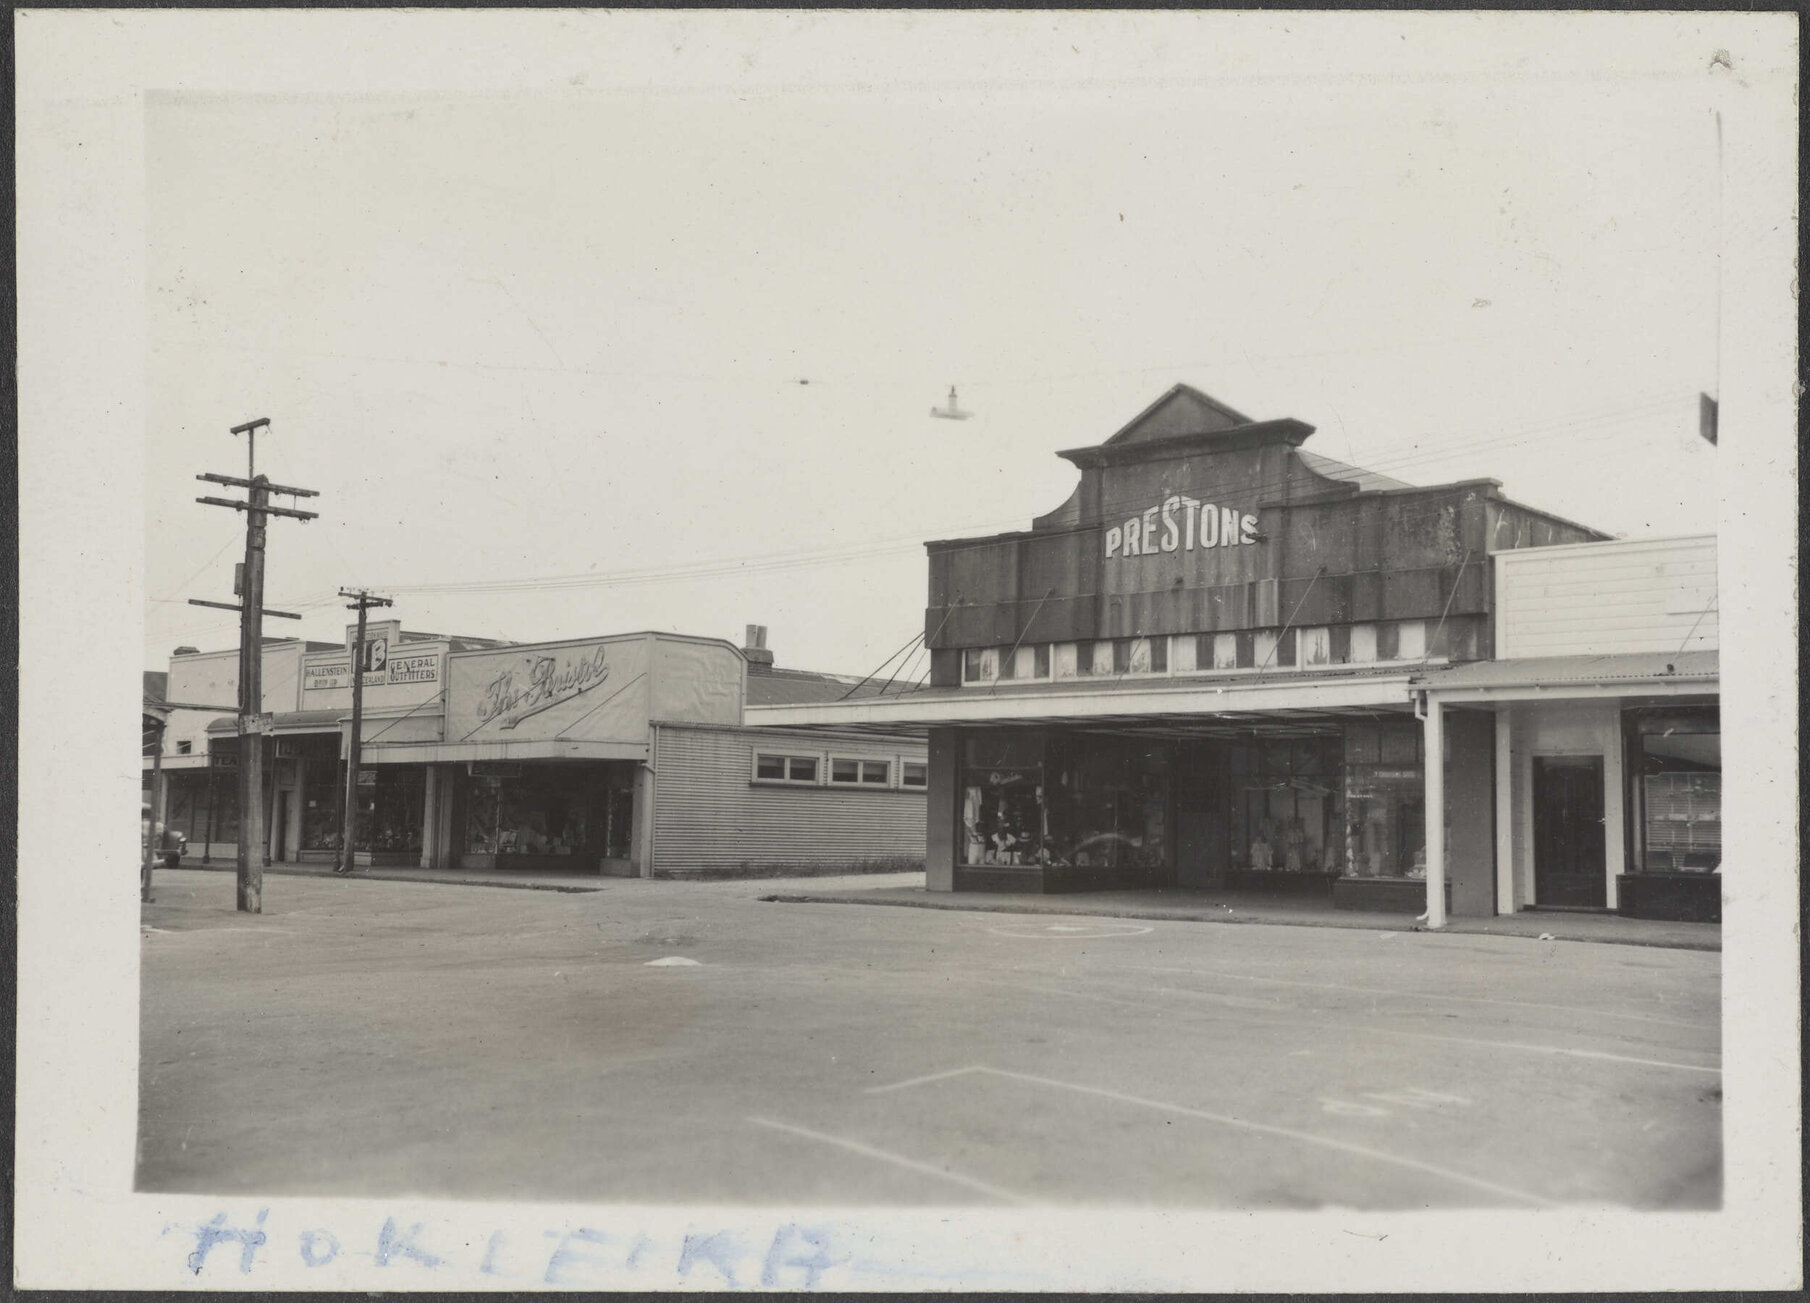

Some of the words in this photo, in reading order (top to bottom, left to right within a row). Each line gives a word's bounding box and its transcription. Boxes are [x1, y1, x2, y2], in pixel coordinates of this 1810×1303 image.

[1105, 496, 1259, 558] PRESTONS
[390, 658, 436, 671] GENERAL
[390, 669, 436, 682] OUTFITTERS
[477, 671, 520, 722] The
[525, 646, 609, 706] Bristol
